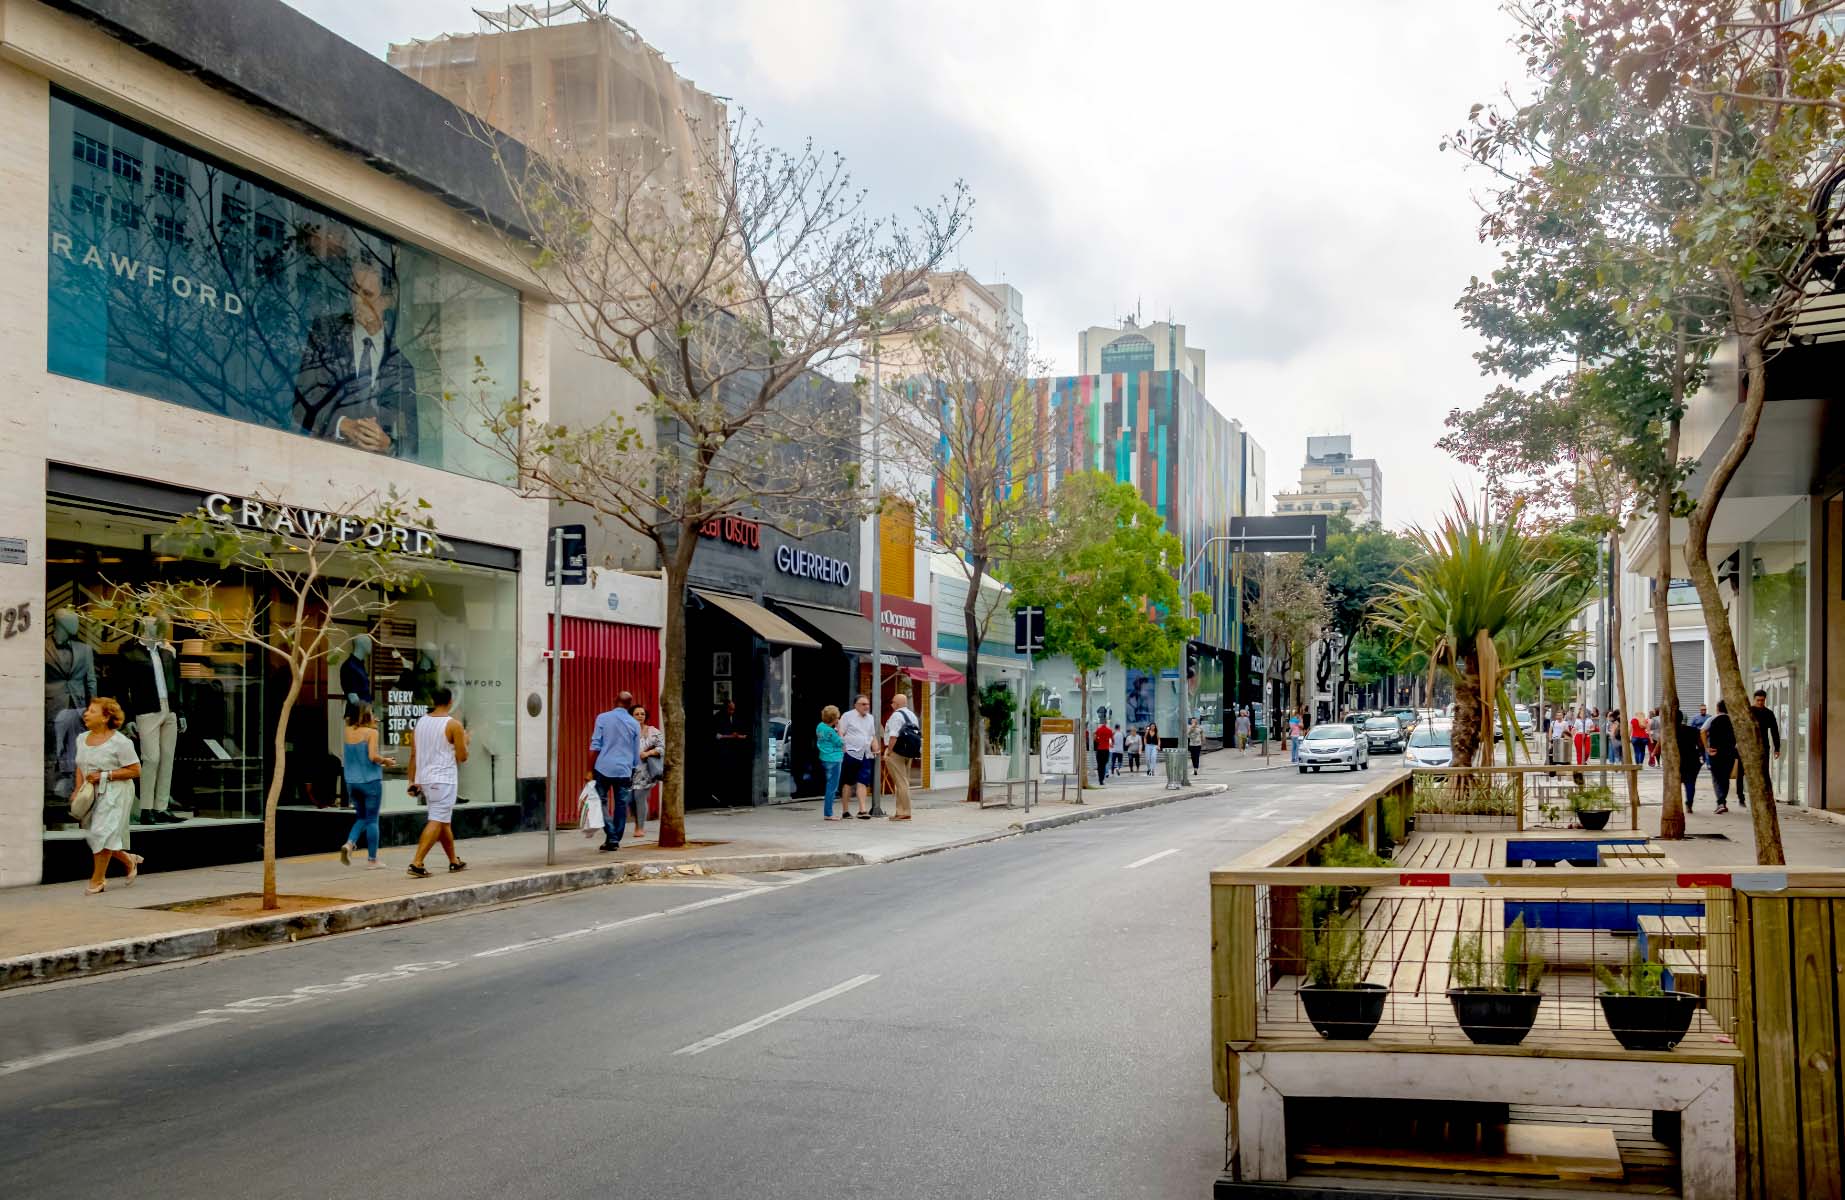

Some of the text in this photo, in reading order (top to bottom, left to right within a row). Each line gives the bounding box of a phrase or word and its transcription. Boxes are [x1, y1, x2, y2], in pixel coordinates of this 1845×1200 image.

[205, 493, 434, 554] CRAWFORD
[777, 545, 851, 586] GUERREIRO
[0, 602, 31, 639] 25
[388, 690, 413, 703] EVERY
[388, 704, 403, 716] DAY
[404, 705, 411, 716] IS
[388, 718, 407, 730] STEP
[388, 733, 400, 744] TO
